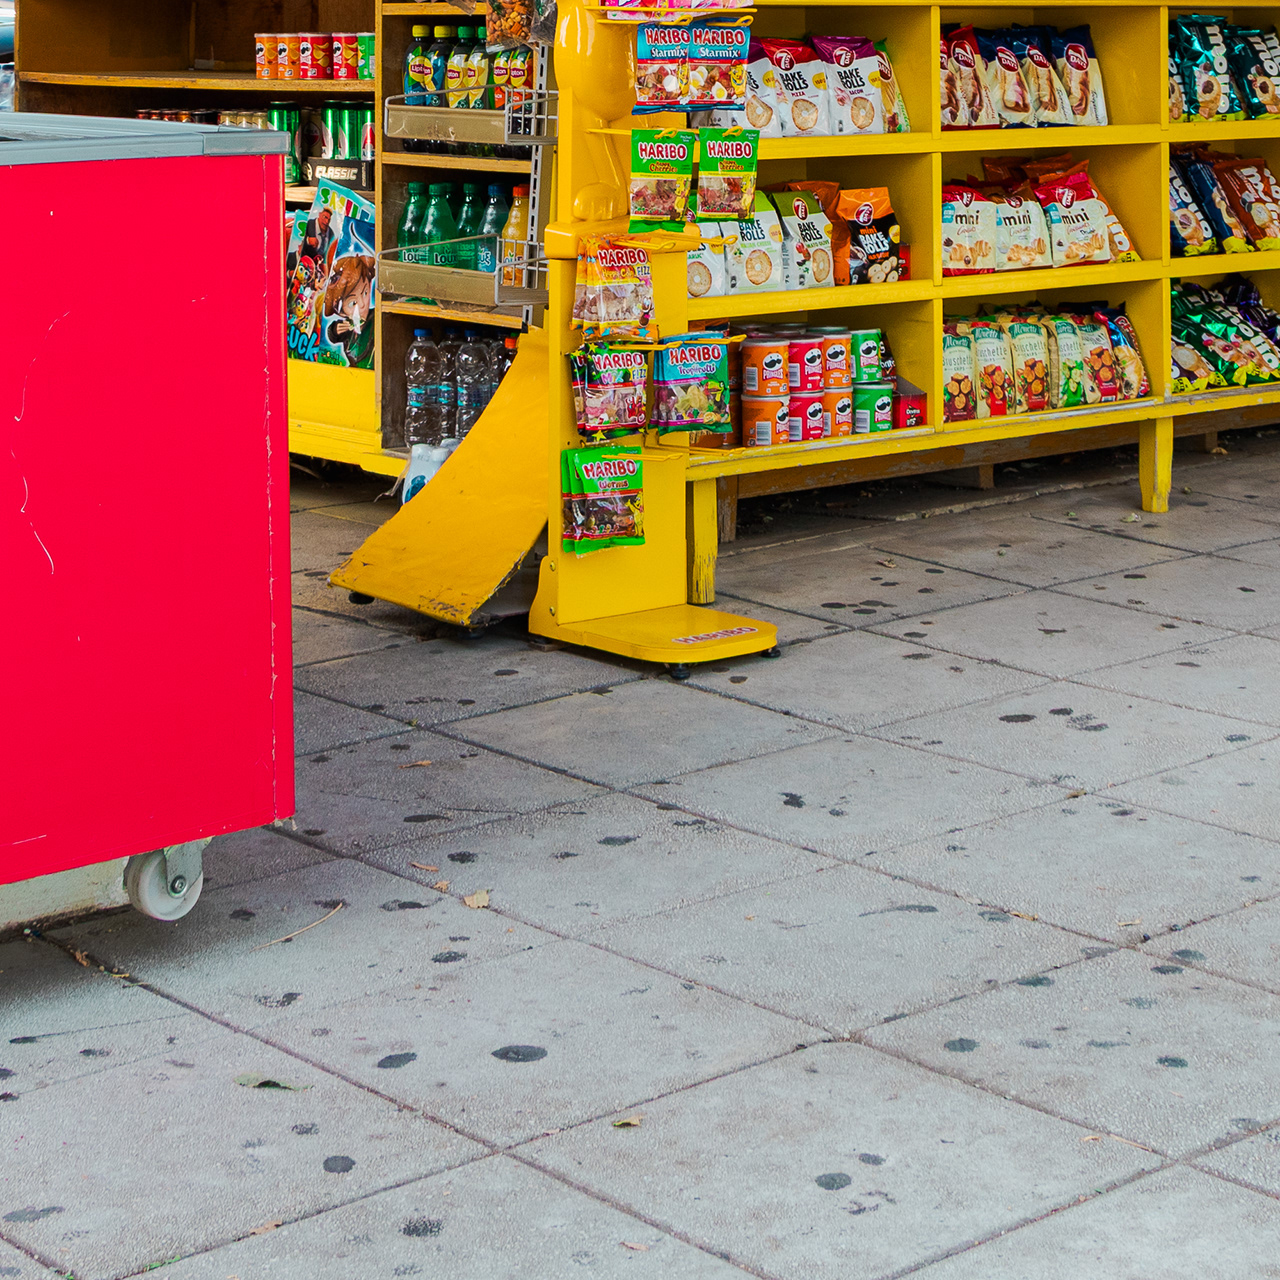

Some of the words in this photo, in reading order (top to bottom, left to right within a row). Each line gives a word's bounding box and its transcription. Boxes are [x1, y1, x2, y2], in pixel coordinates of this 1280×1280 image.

[645, 29, 691, 45] HARIBO
[692, 30, 746, 46] HARIBO
[650, 45, 688, 59] Starmix
[698, 46, 740, 59] Starmix
[778, 70, 805, 81] BAKE
[836, 67, 861, 80] BAKE
[848, 88, 865, 96] BACON
[638, 141, 688, 161] HARIBO
[706, 140, 753, 159] HARIBO
[314, 166, 359, 181] CLASSIC
[796, 221, 820, 233] BAKE
[800, 230, 823, 243] ROLLS
[597, 248, 648, 267] HARIBO
[667, 344, 722, 364] HARIBO
[582, 458, 638, 479] HARIBO
